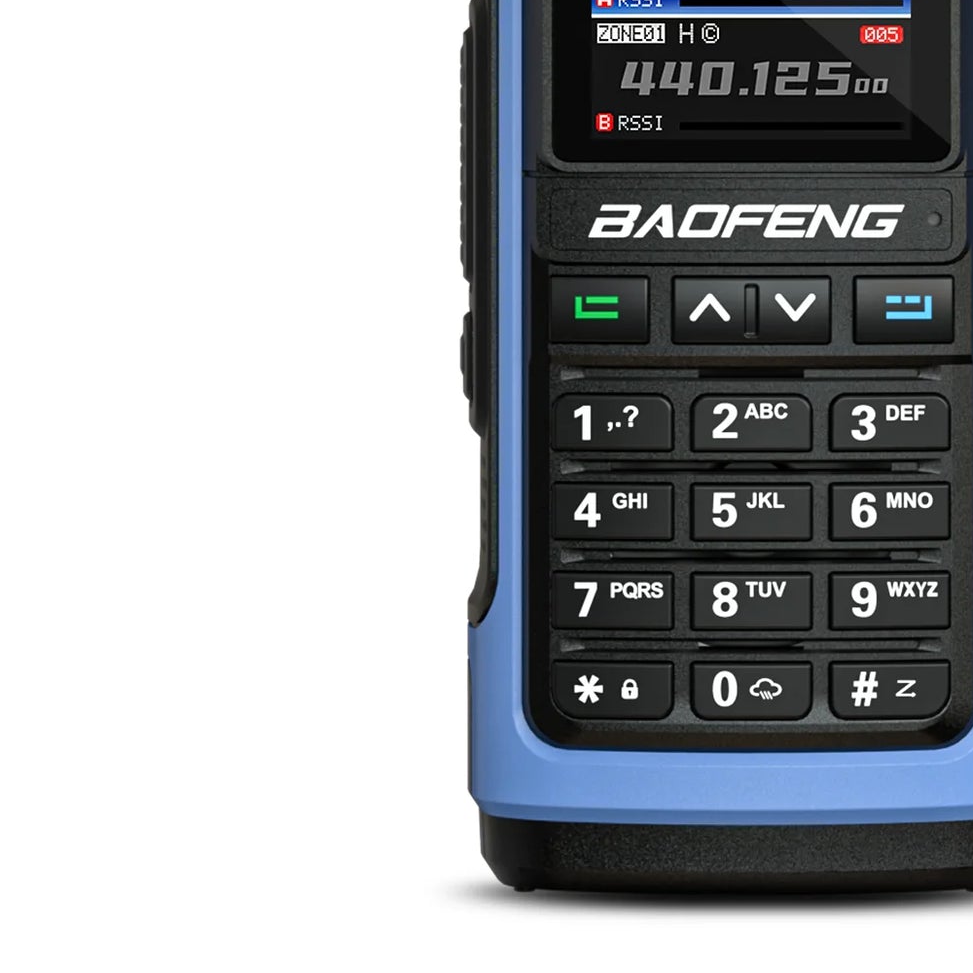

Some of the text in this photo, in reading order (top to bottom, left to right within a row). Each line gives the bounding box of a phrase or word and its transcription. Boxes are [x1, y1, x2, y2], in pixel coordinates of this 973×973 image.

[599, 25, 663, 41] ZONE01
[680, 23, 693, 44] H
[864, 27, 898, 43] 005
[621, 61, 852, 95] 440.125
[619, 115, 662, 130] RSSI
[588, 204, 905, 238] BAOFENG
[574, 405, 591, 440] 1
[712, 403, 788, 438] 2 ABC
[851, 405, 926, 441] 3 DEF
[574, 493, 647, 527] 4 GHI
[713, 492, 785, 527] 5 JKL
[851, 492, 933, 528] 6 MNO
[574, 582, 664, 617] 7 PQRS
[712, 581, 786, 617] 8 TUV
[851, 581, 938, 617] 9 WXYZ
[712, 671, 737, 707] 0
[851, 671, 878, 706] #
